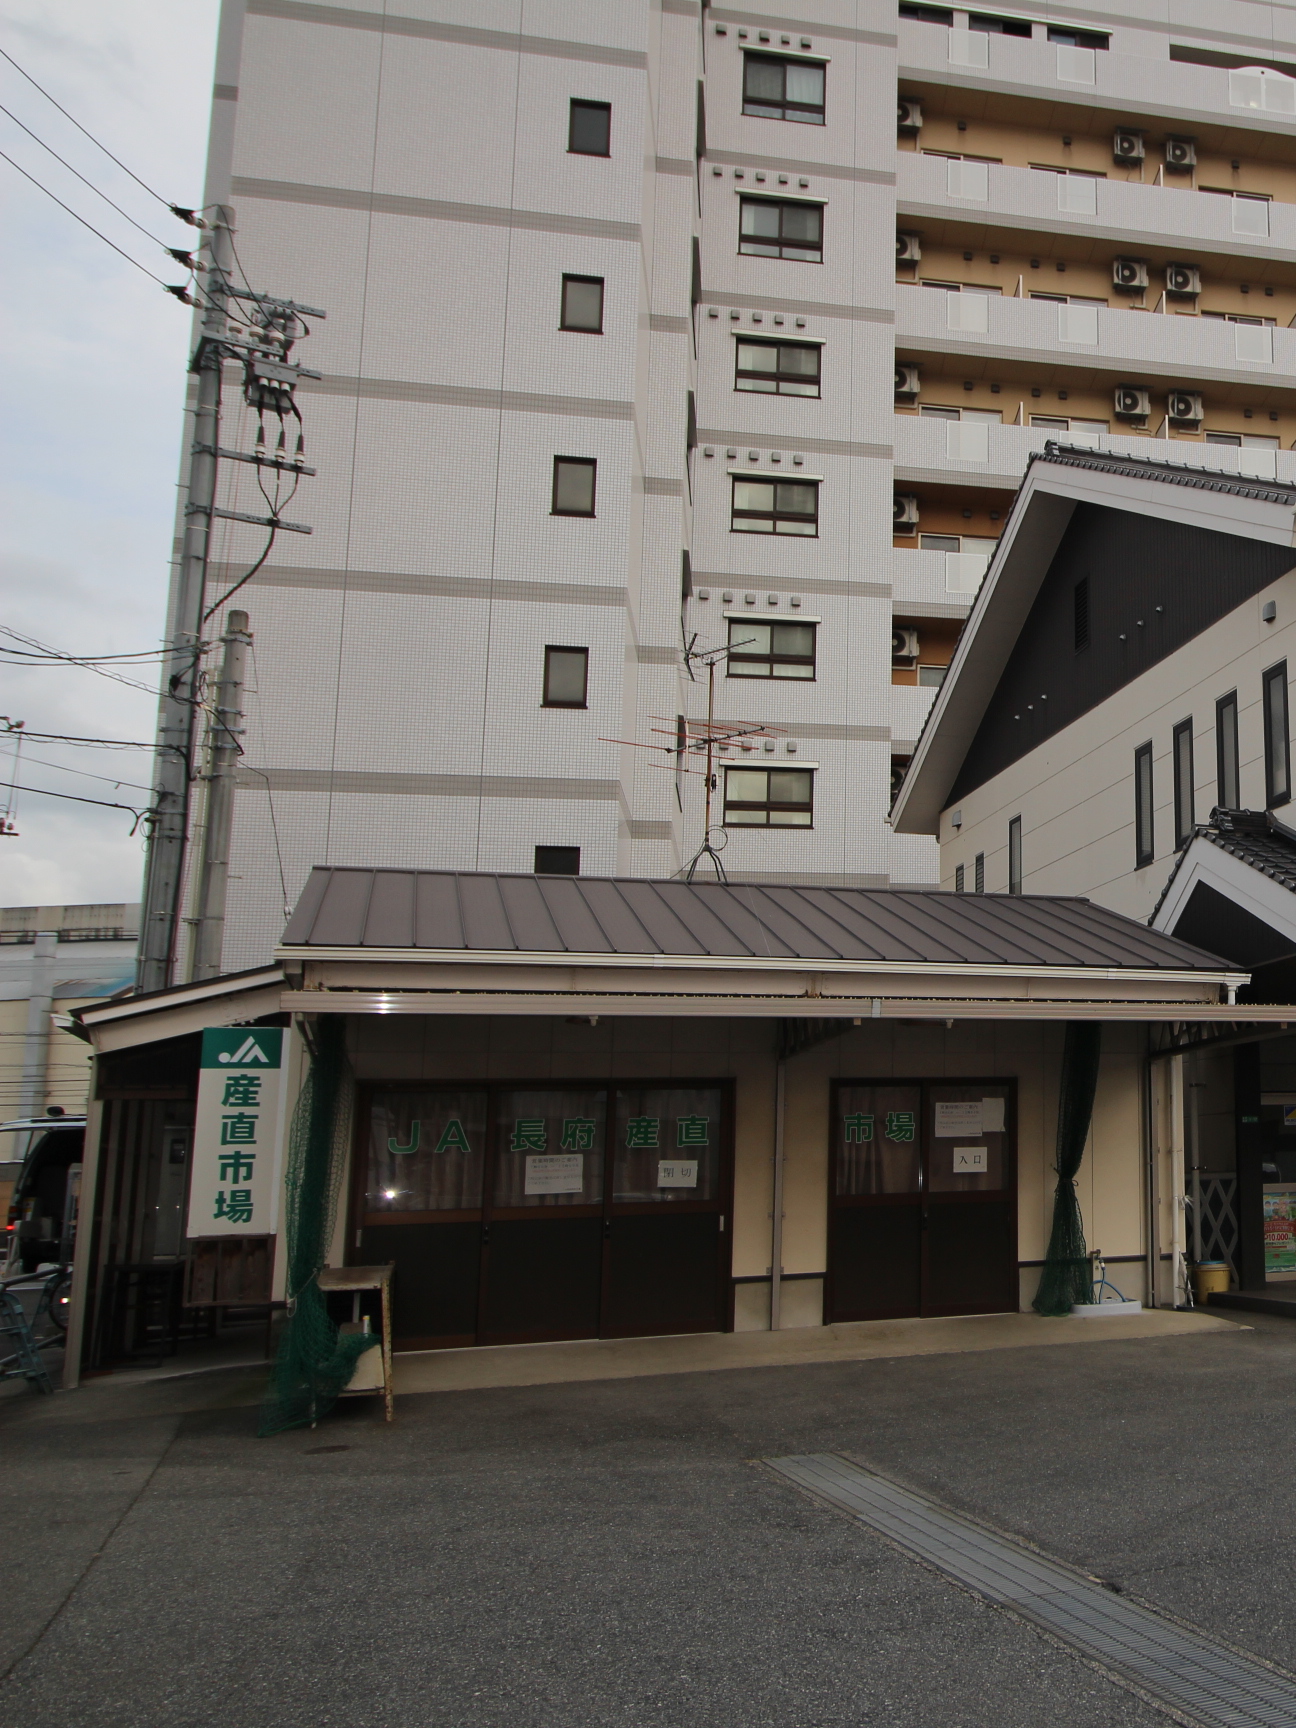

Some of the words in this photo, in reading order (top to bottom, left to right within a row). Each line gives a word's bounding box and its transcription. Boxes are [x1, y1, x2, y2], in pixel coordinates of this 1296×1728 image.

[213, 1073, 262, 1225] 産直市場
[388, 1119, 472, 1155] JA
[844, 1112, 916, 1144] 市場
[958, 1154, 982, 1165] 入口
